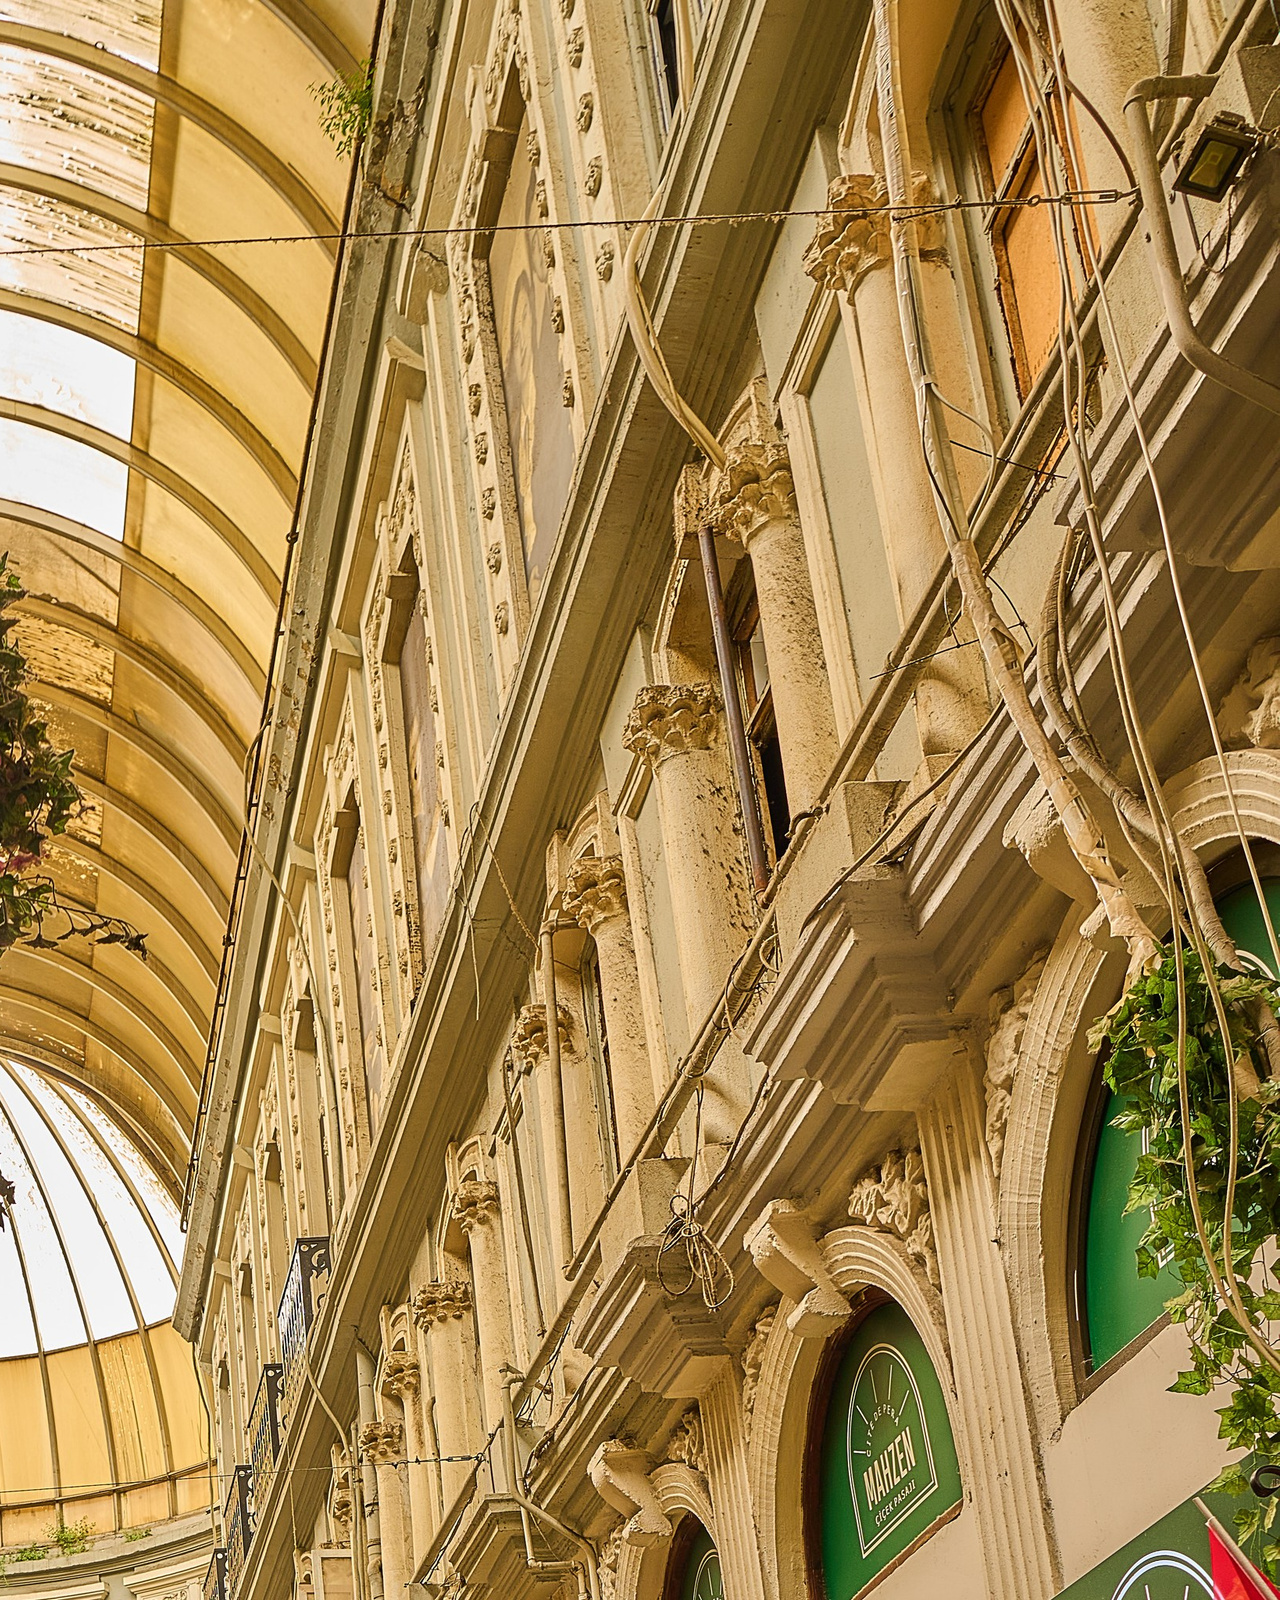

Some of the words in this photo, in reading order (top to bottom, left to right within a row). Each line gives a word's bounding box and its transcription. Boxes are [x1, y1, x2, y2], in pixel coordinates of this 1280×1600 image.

[866, 1421, 875, 1457] CITE
[873, 1405, 882, 1422] DE
[883, 1403, 900, 1426] PERA
[863, 1426, 917, 1511] MAHZEN
[875, 1500, 895, 1527] ÇİÇEK
[893, 1479, 917, 1506] PASAJI
